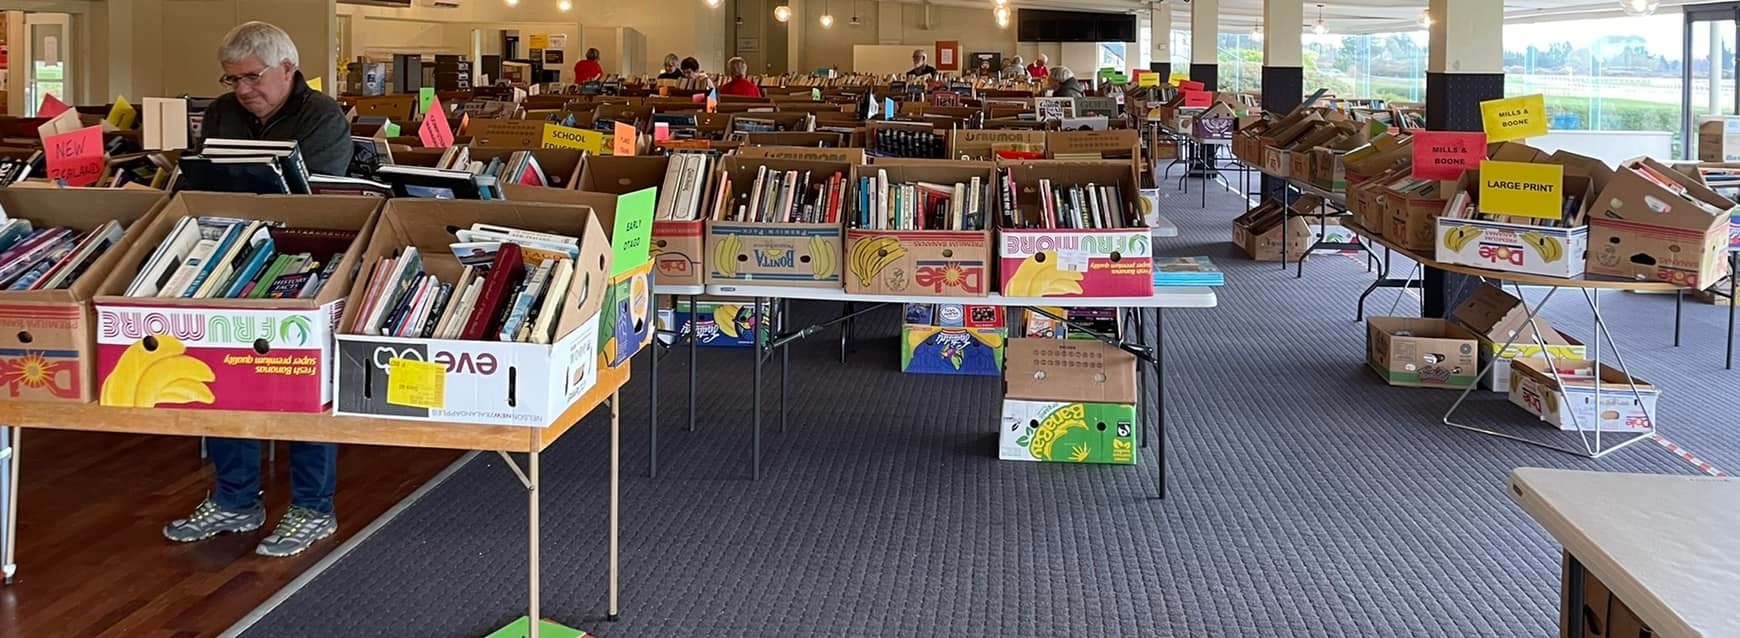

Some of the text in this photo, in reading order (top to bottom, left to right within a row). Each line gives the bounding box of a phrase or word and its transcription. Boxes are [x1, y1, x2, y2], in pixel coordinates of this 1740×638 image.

[1499, 110, 1522, 118] MILLS
[1502, 119, 1529, 128] BOONE
[552, 130, 585, 143] SCHOOL
[55, 136, 86, 160] NEW
[1434, 158, 1465, 166] BOONE
[1487, 180, 1554, 193] LARGE PRINT
[626, 219, 642, 232] EARLY
[623, 237, 641, 251] OTAGO
[755, 249, 795, 268] BONITA
[1479, 245, 1524, 266] Dole
[915, 263, 983, 293] Dole
[102, 311, 276, 344] FRUMORE
[223, 354, 316, 366] super premium quality
[434, 350, 498, 376] eve
[255, 365, 316, 375] Fresh Bananas
